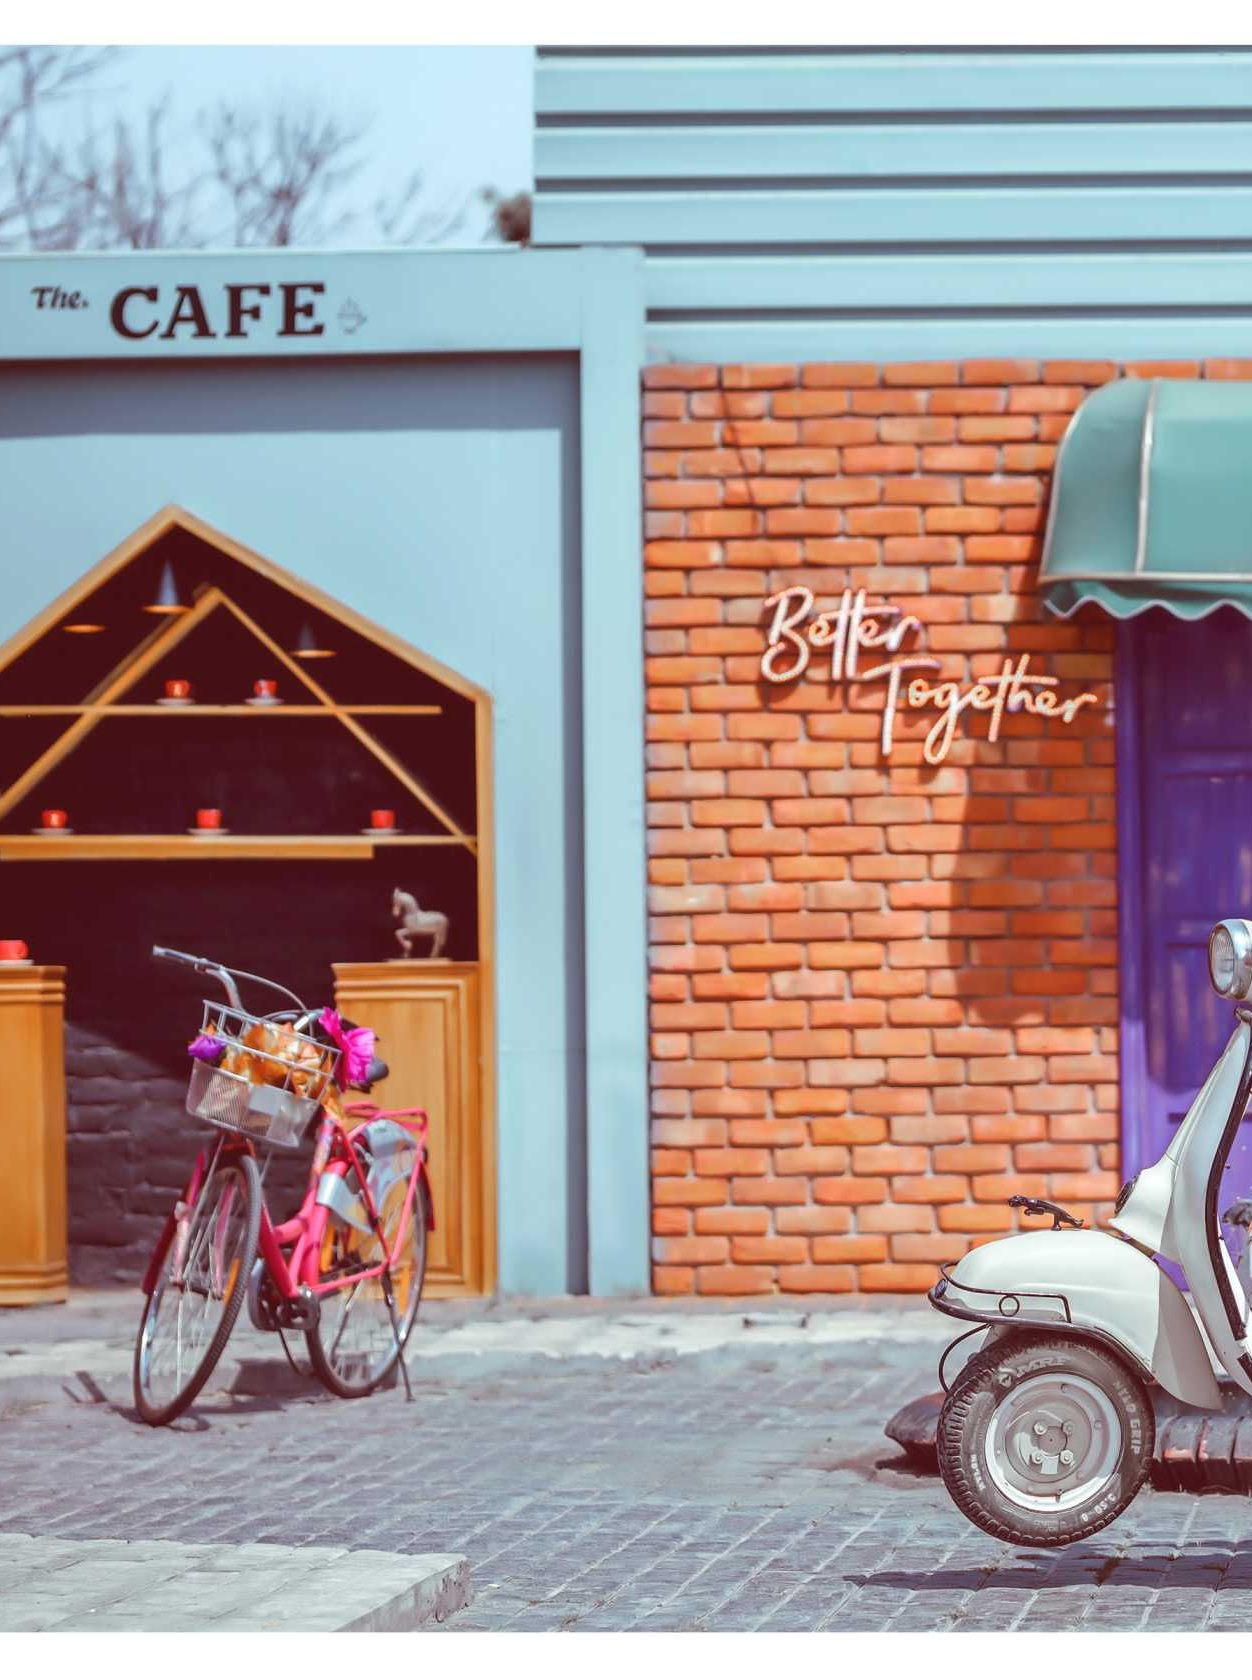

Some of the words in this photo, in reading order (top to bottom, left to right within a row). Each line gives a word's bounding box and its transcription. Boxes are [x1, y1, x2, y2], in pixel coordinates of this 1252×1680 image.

[109, 282, 326, 340] CAFE
[761, 586, 922, 682] Better
[863, 653, 1098, 764] Together
[1130, 1418, 1142, 1455] GRIP
